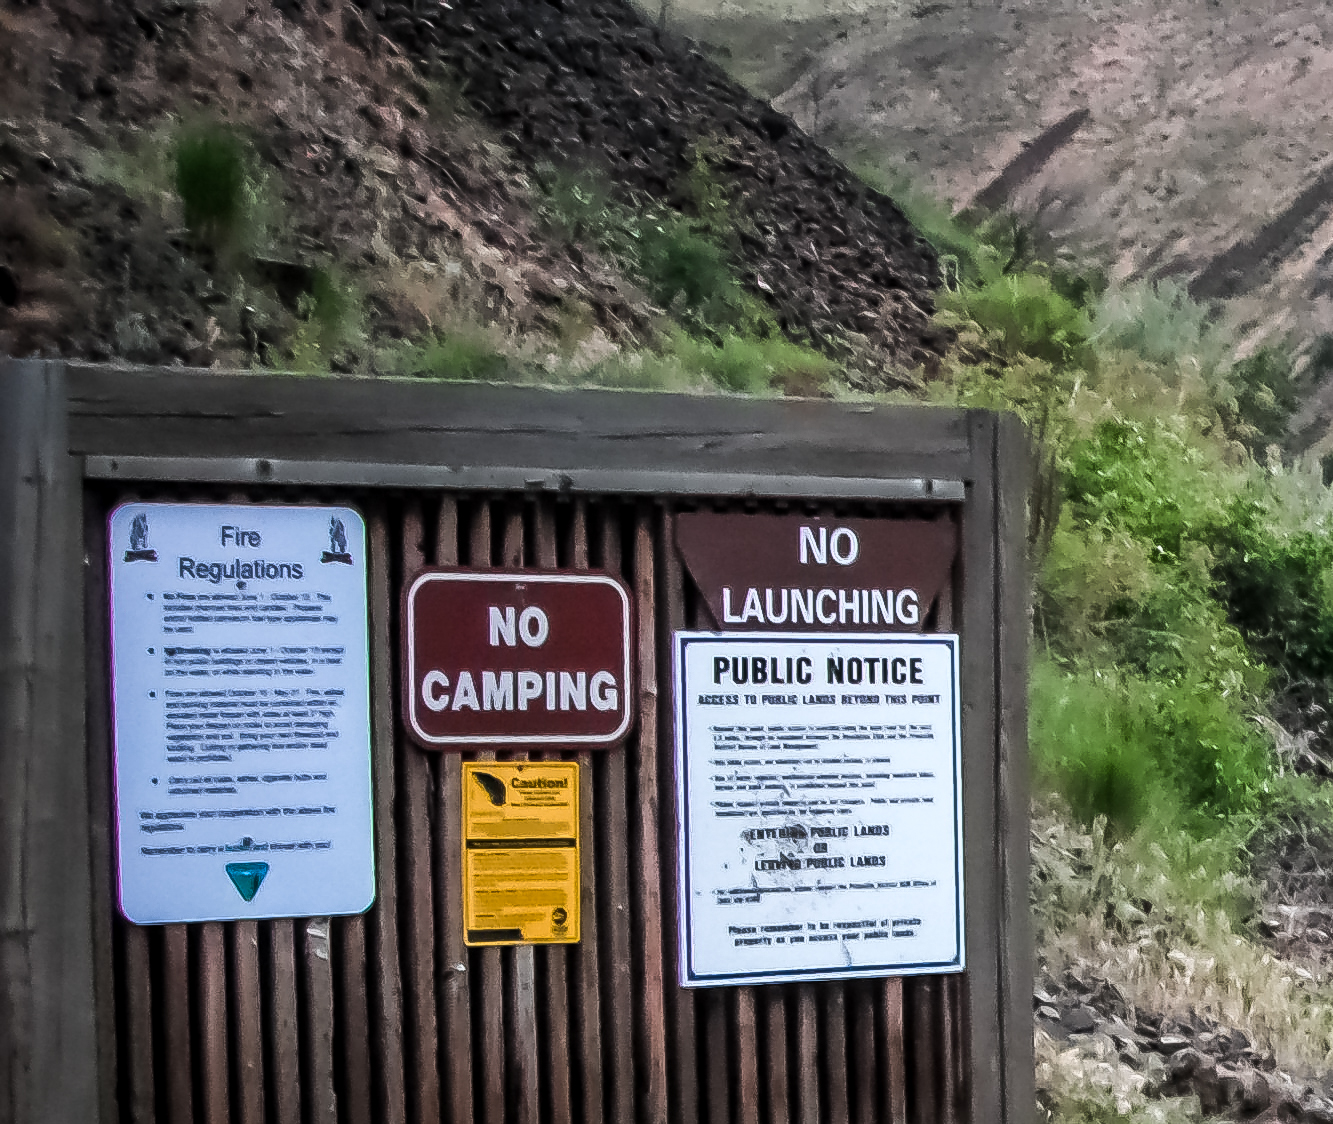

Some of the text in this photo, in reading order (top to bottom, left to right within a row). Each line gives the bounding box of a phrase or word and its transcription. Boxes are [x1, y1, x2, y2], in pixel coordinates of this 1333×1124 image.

[220, 525, 262, 548] Fire
[799, 526, 859, 566] NO
[178, 557, 304, 584] Regulations
[722, 587, 920, 625] LAUNCHING
[488, 605, 550, 648] NO
[713, 656, 924, 685] PUBLIC NOTICE
[421, 669, 619, 712] CAMPING
[698, 695, 941, 705] ACCESS TO PUBLIC LANDS BEYOND THIS POINT
[511, 777, 569, 789] Caution!
[810, 827, 849, 838] PUBLIC
[854, 825, 890, 836] LANDS
[806, 857, 845, 869] PUBLIC
[850, 855, 886, 867] LANDS
